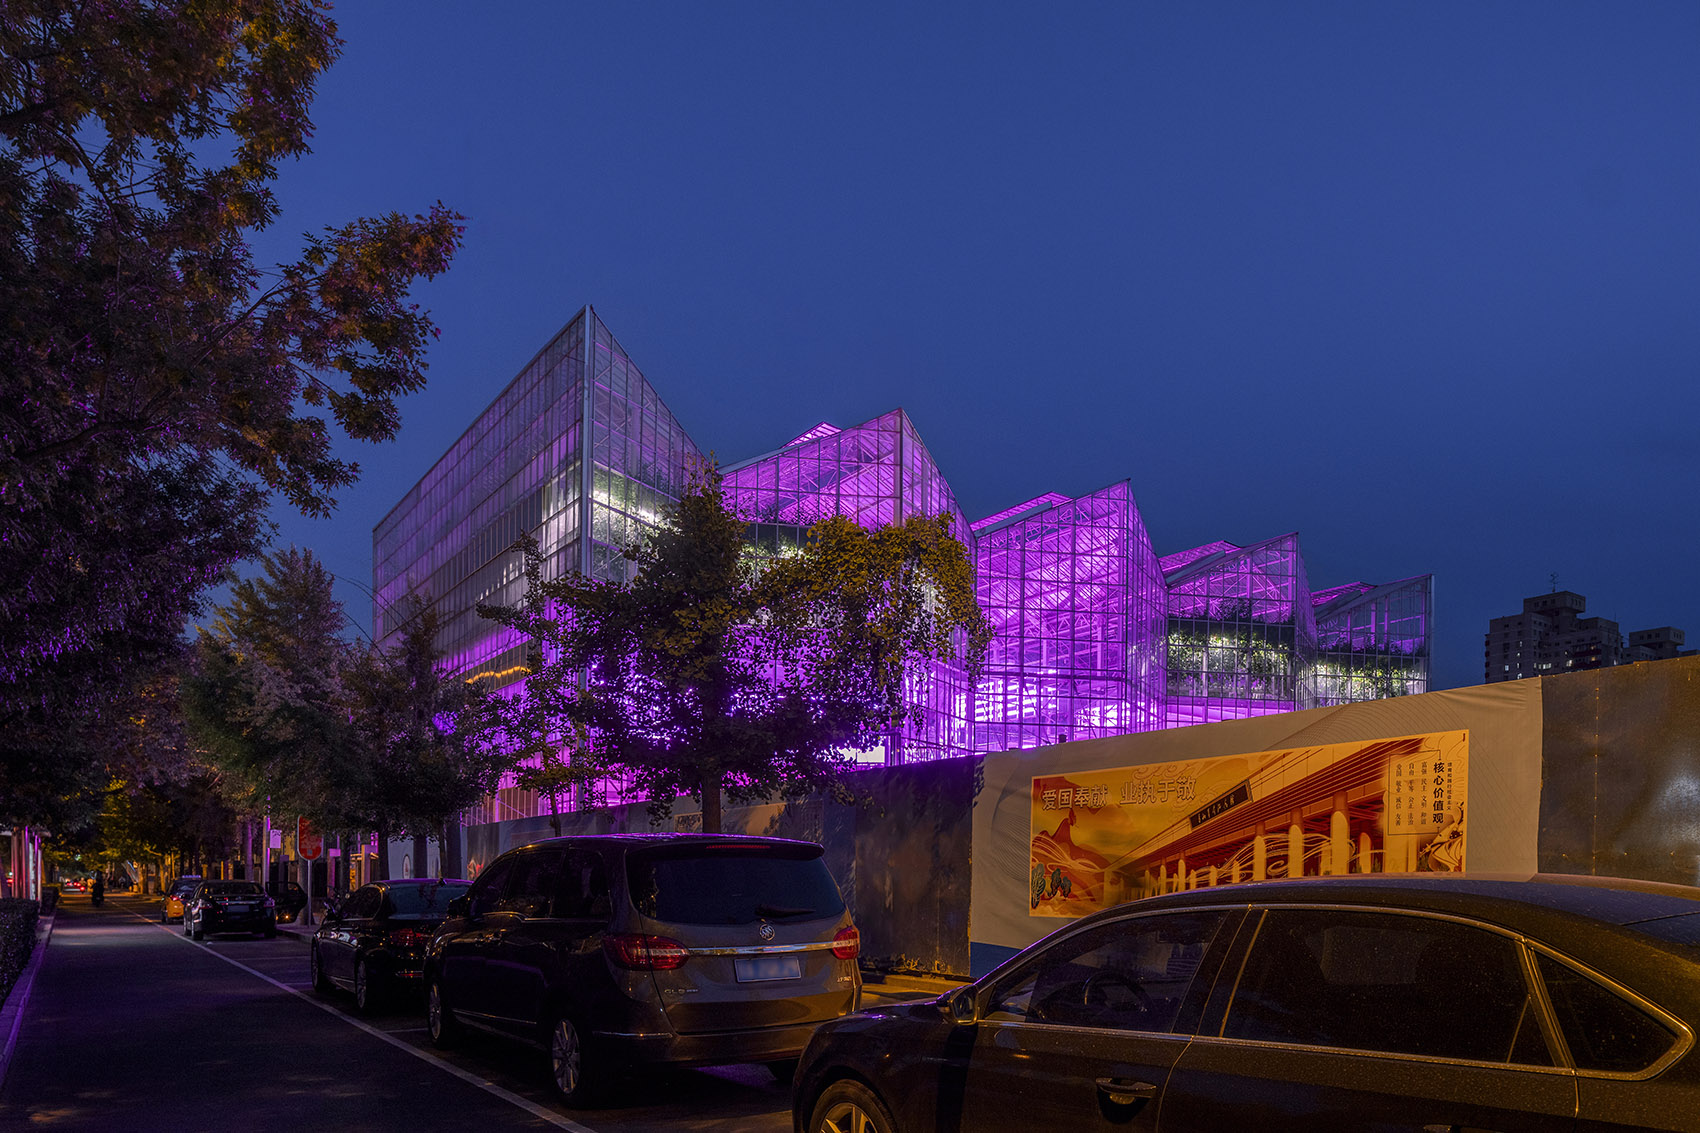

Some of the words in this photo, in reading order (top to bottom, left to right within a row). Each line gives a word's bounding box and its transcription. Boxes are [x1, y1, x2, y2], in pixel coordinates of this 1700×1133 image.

[1041, 783, 1108, 811] 爱国奉献
[1119, 775, 1197, 806] 业执于敬
[1433, 762, 1444, 823] 核心价值观
